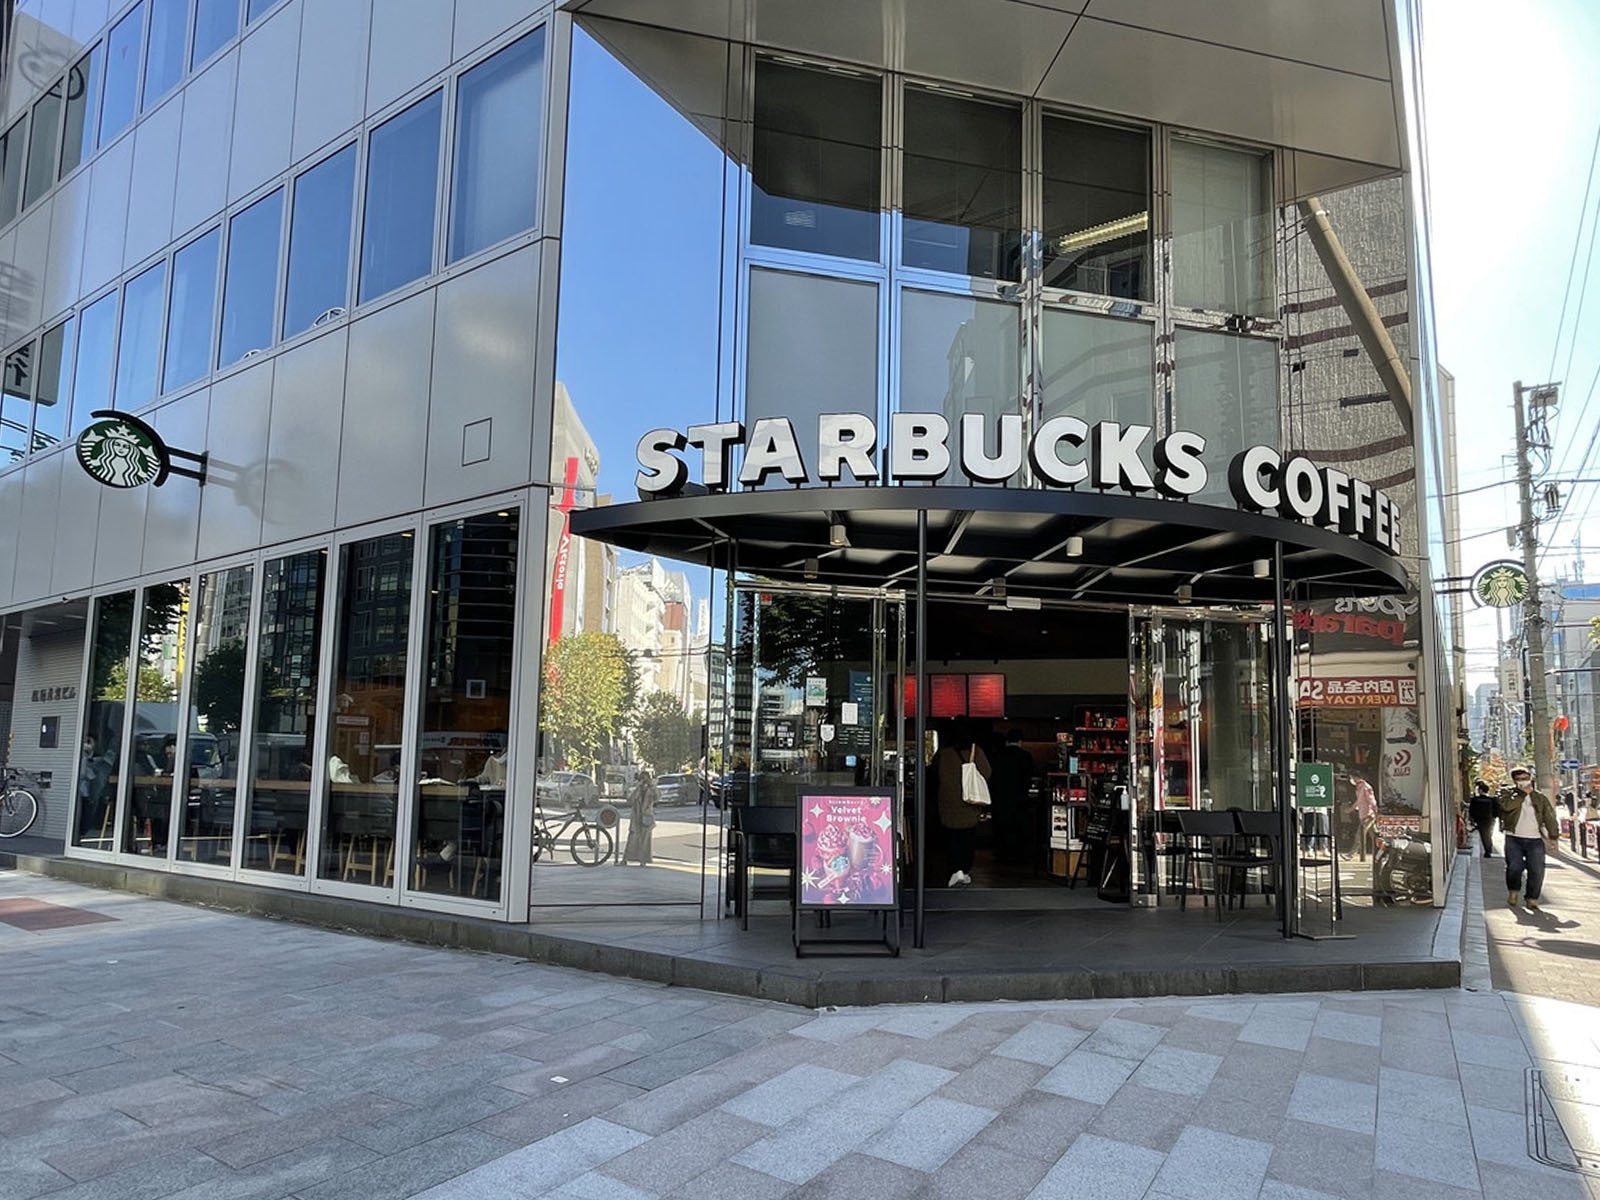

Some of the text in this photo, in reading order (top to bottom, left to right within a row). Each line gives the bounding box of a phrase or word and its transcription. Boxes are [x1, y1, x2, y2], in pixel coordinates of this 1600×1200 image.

[634, 411, 1401, 556] STARBUCKS COFFEE
[831, 806, 862, 814] Velvet
[826, 814, 867, 823] Brownie
